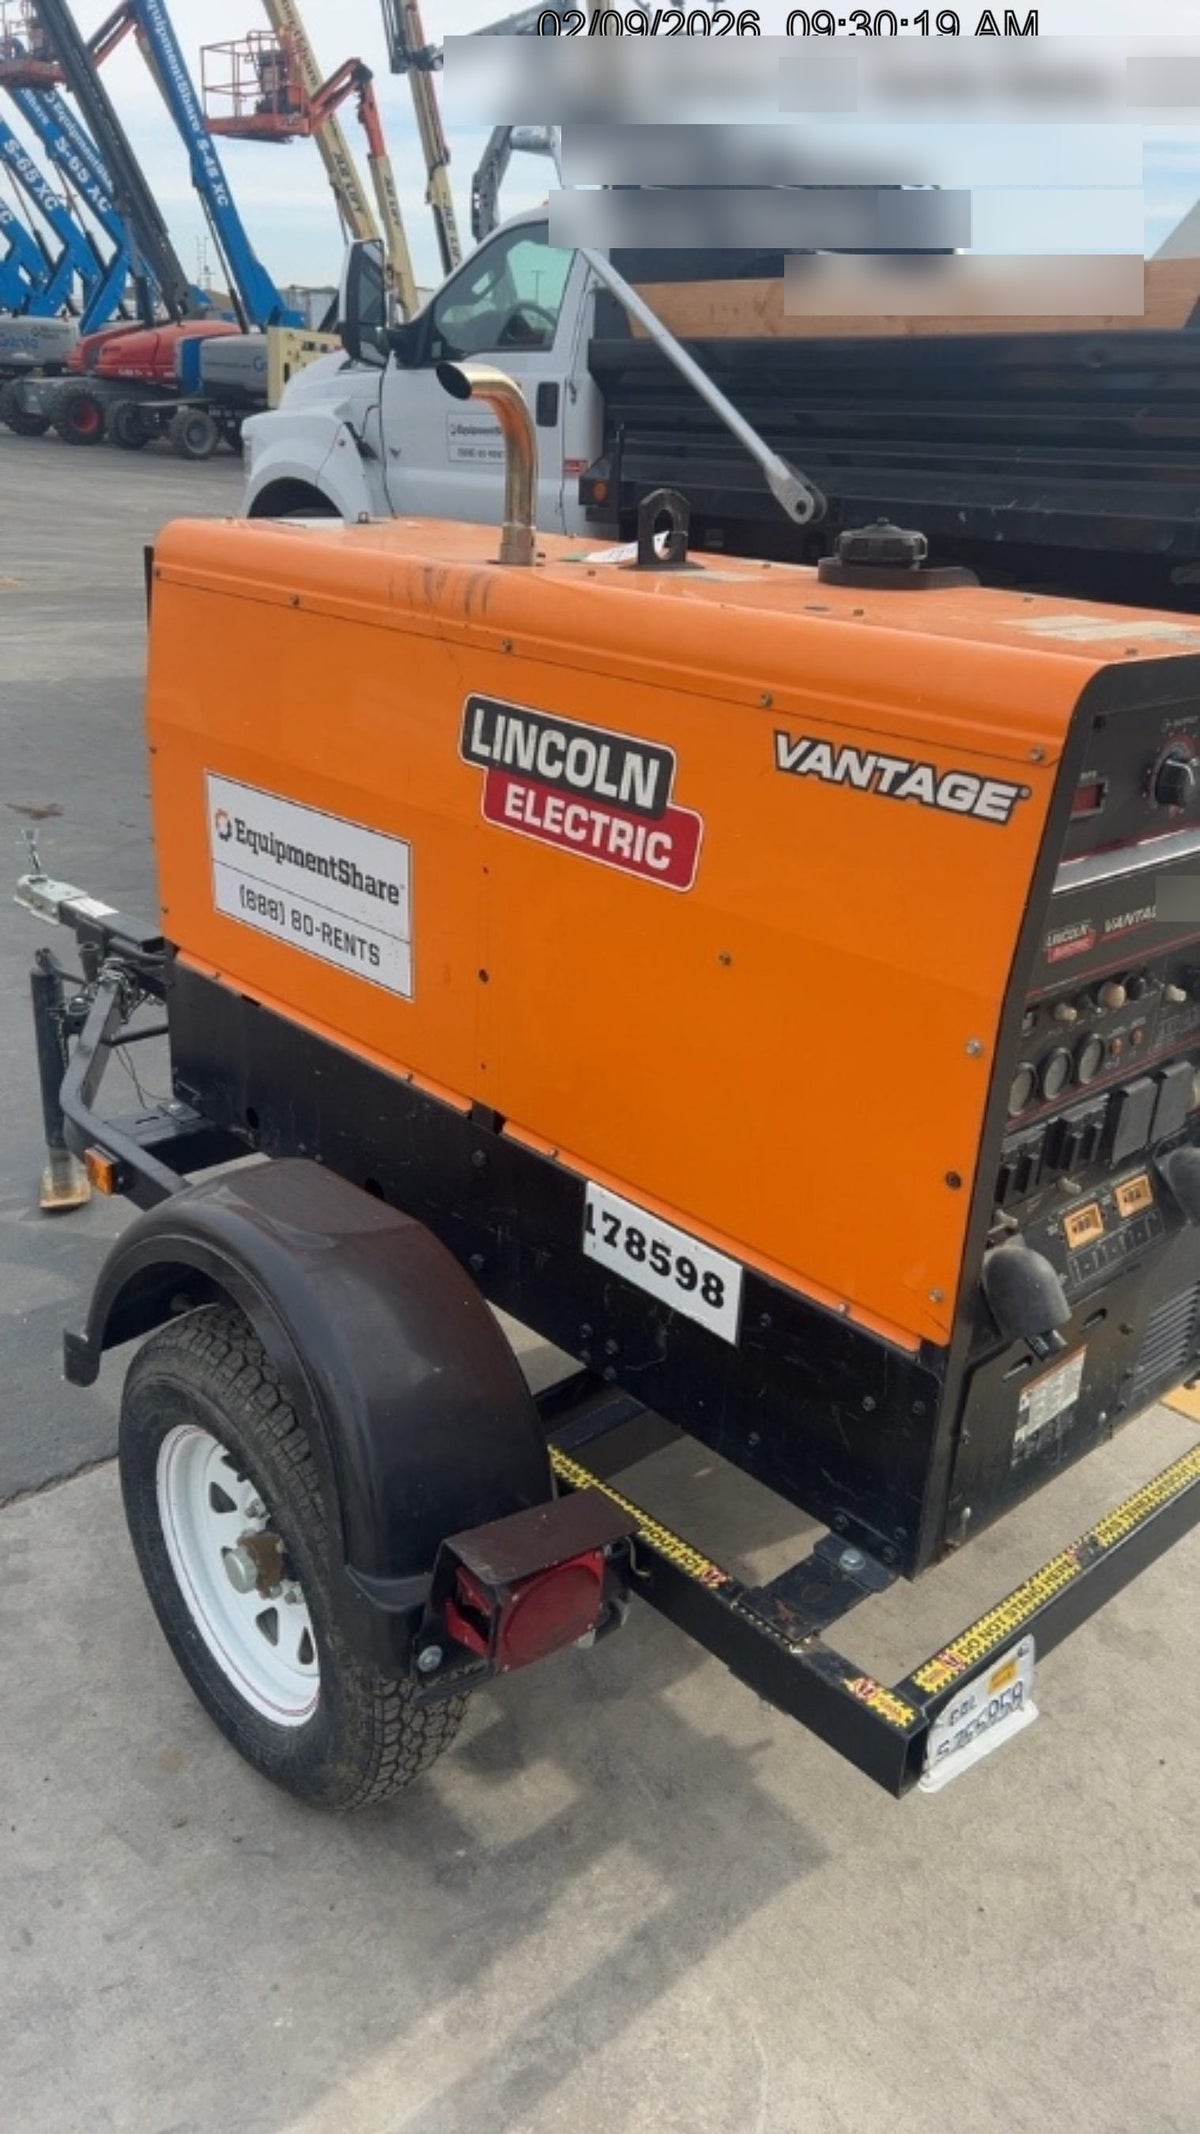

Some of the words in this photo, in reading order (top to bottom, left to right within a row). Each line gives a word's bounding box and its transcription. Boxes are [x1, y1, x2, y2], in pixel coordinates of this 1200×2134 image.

[33, 182, 59, 211] XC
[470, 708, 661, 810] LINCOLN
[235, 818, 400, 906] EquipmentShare
[504, 782, 673, 871] ELECTRIC
[239, 884, 286, 925] (888)
[291, 909, 380, 967] 80-RENTS
[585, 1202, 725, 1310] 178598
